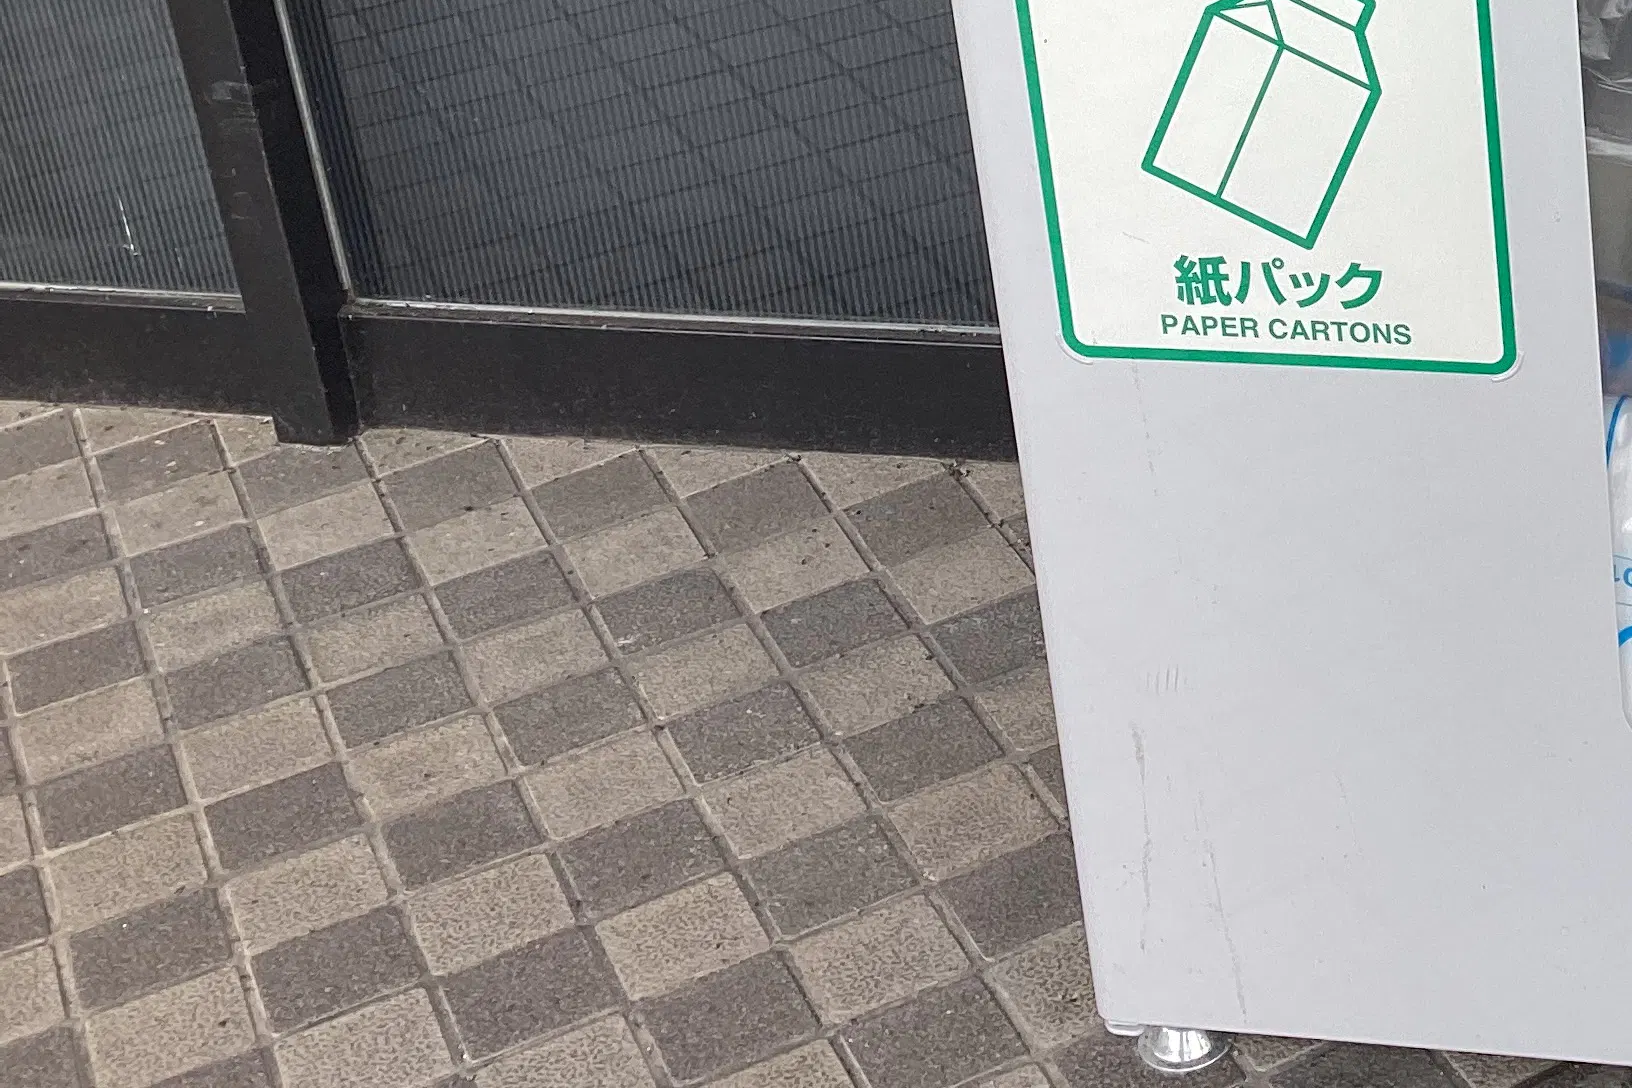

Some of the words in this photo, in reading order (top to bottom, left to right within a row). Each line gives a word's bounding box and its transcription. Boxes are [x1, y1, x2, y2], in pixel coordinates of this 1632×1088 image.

[1173, 254, 1383, 310] 紙パック
[1160, 314, 1260, 338] PAPER
[1268, 318, 1412, 345] CARTONS
